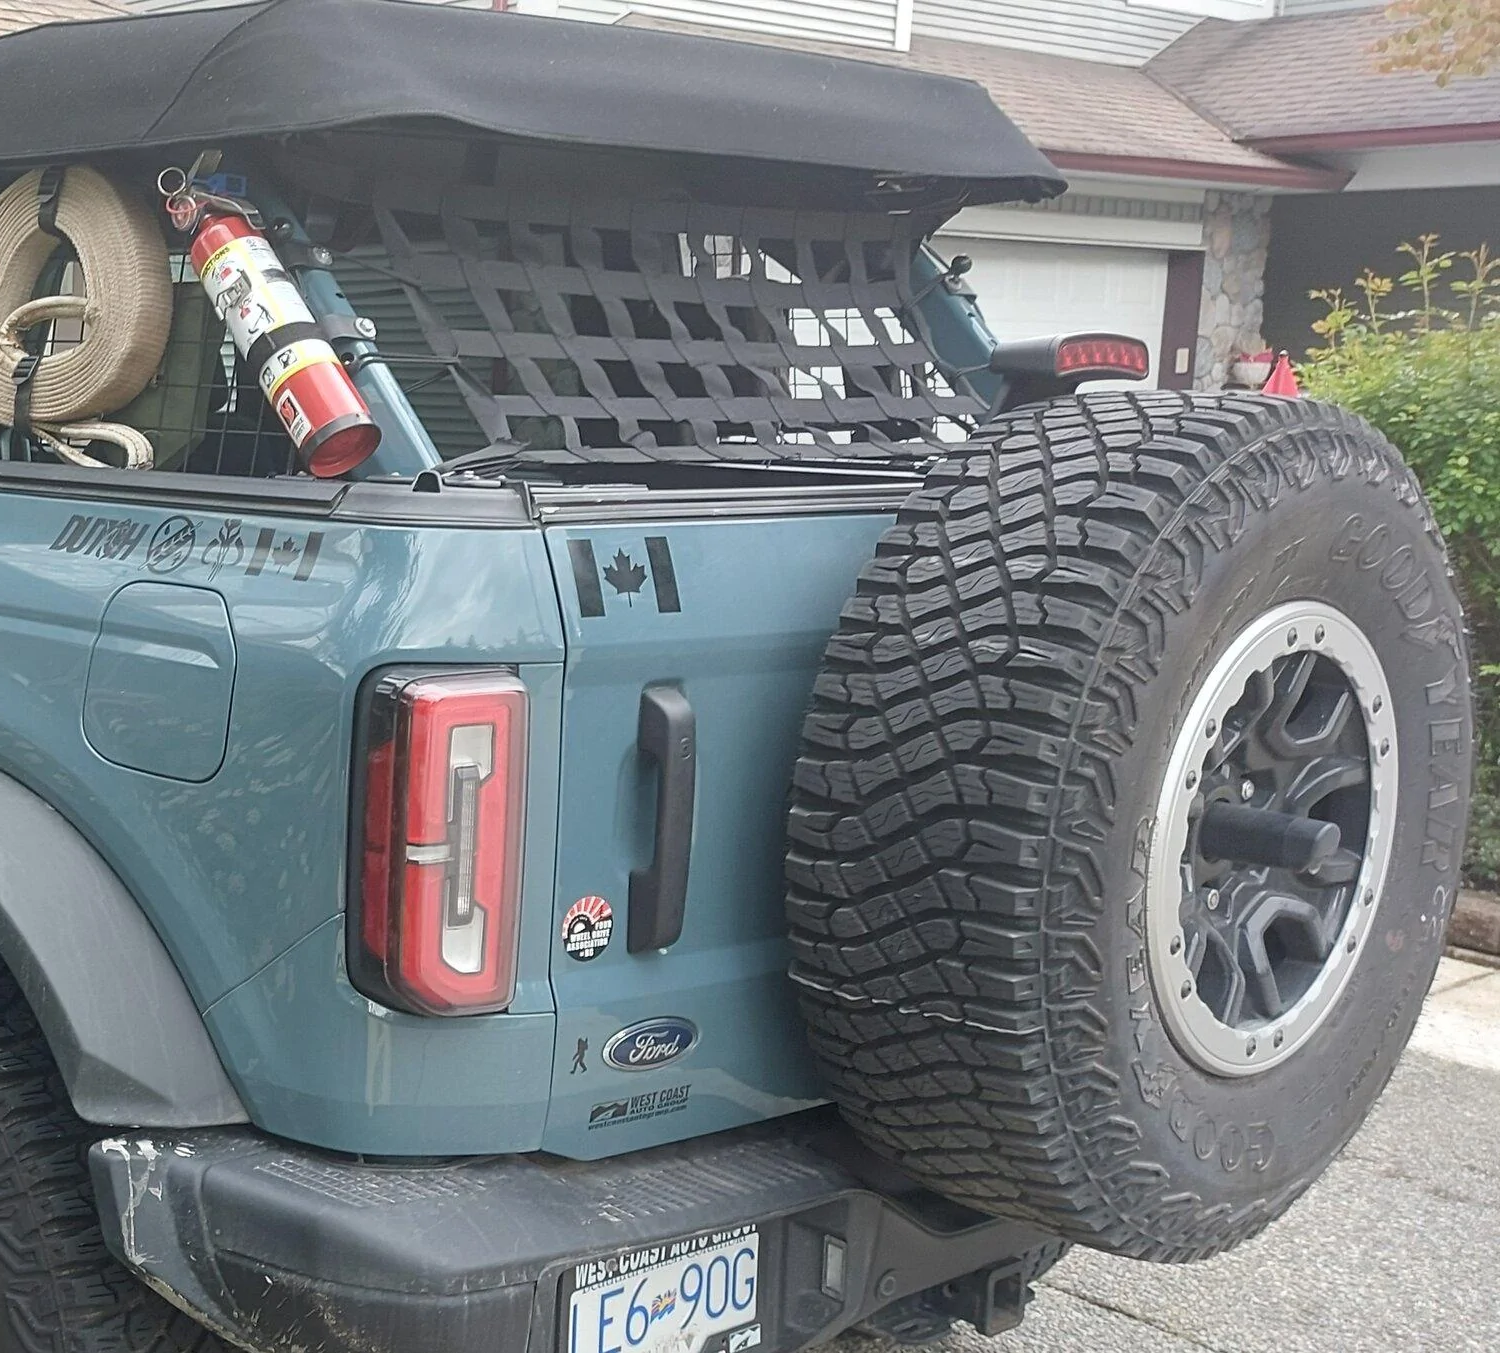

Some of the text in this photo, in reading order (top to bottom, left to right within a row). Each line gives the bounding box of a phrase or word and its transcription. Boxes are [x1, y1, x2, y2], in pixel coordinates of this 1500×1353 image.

[1329, 513, 1463, 871] GOODYEAR
[629, 1030, 680, 1063] Ford
[629, 1105, 655, 1115] AUTO
[630, 1084, 692, 1109] WEST COAST
[680, 1248, 755, 1330] 90G
